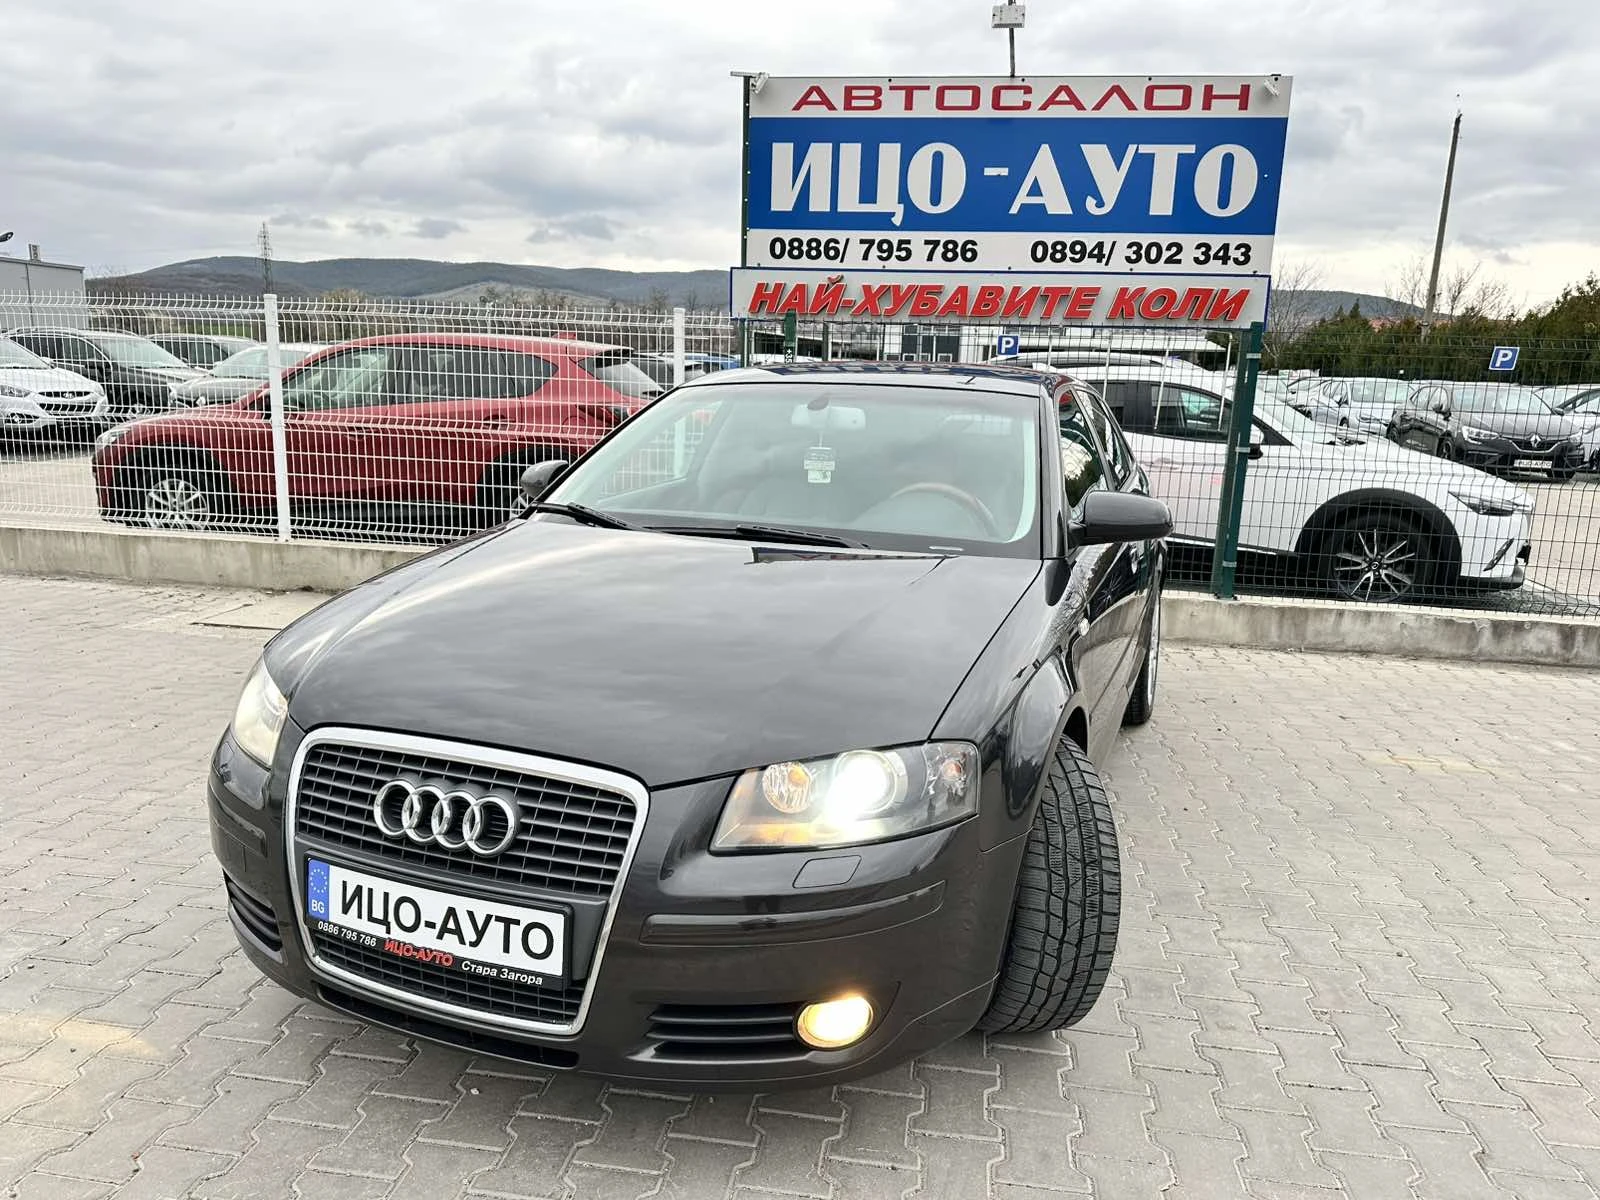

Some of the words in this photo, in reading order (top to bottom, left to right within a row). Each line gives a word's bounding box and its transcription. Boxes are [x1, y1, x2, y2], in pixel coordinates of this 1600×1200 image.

[792, 84, 1250, 111] АВТОСАЛОН
[769, 236, 850, 263] 0886/
[859, 238, 912, 261] 795
[924, 239, 978, 262] 786
[1030, 240, 1116, 266] 0894/
[1124, 241, 1183, 265] 302
[1193, 243, 1252, 266] 343
[748, 274, 1101, 320] НАЙ-ХУБАВИТЕ
[1106, 287, 1251, 322] КОЛИ
[1001, 337, 1014, 353] P
[1495, 350, 1513, 367] P
[311, 899, 325, 914] BG
[341, 880, 555, 961] ИЦО-АУТО
[318, 920, 339, 935] 0886
[341, 928, 358, 941] 795
[359, 934, 377, 947] 786
[383, 938, 454, 967] ИЦО-АУТО
[461, 960, 498, 977] Стара
[500, 969, 544, 986] Загора
